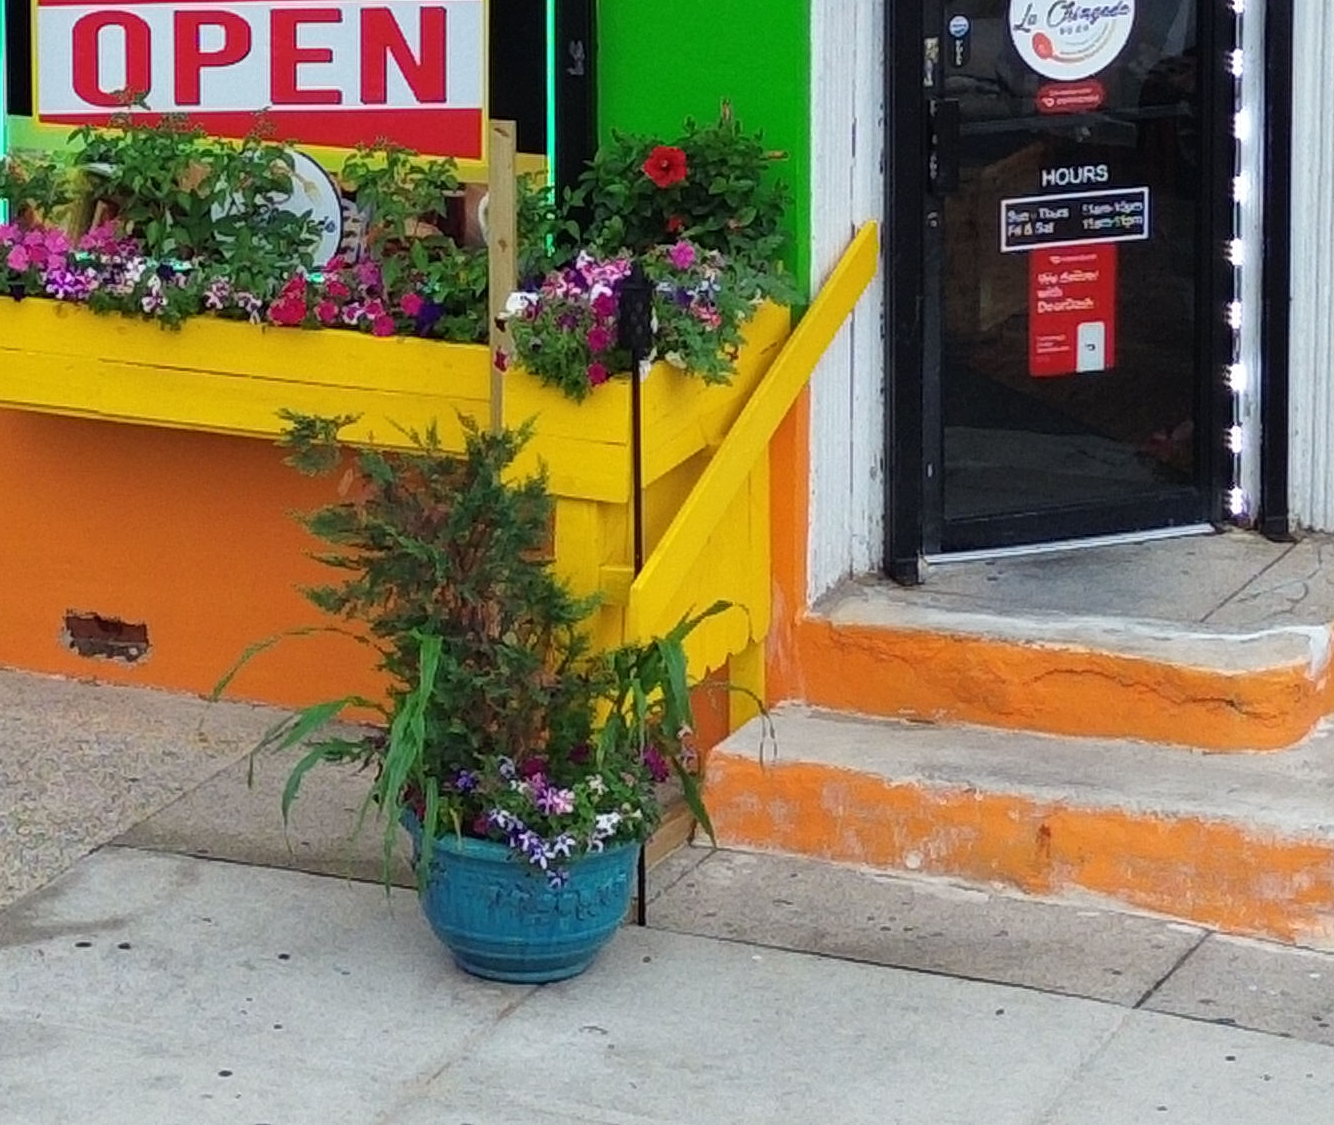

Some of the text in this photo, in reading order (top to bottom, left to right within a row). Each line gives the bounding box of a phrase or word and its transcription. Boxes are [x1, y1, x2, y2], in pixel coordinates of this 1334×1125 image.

[1012, 2, 1038, 33] La
[72, 6, 447, 107] OPEN
[1041, 164, 1109, 187] HOURS
